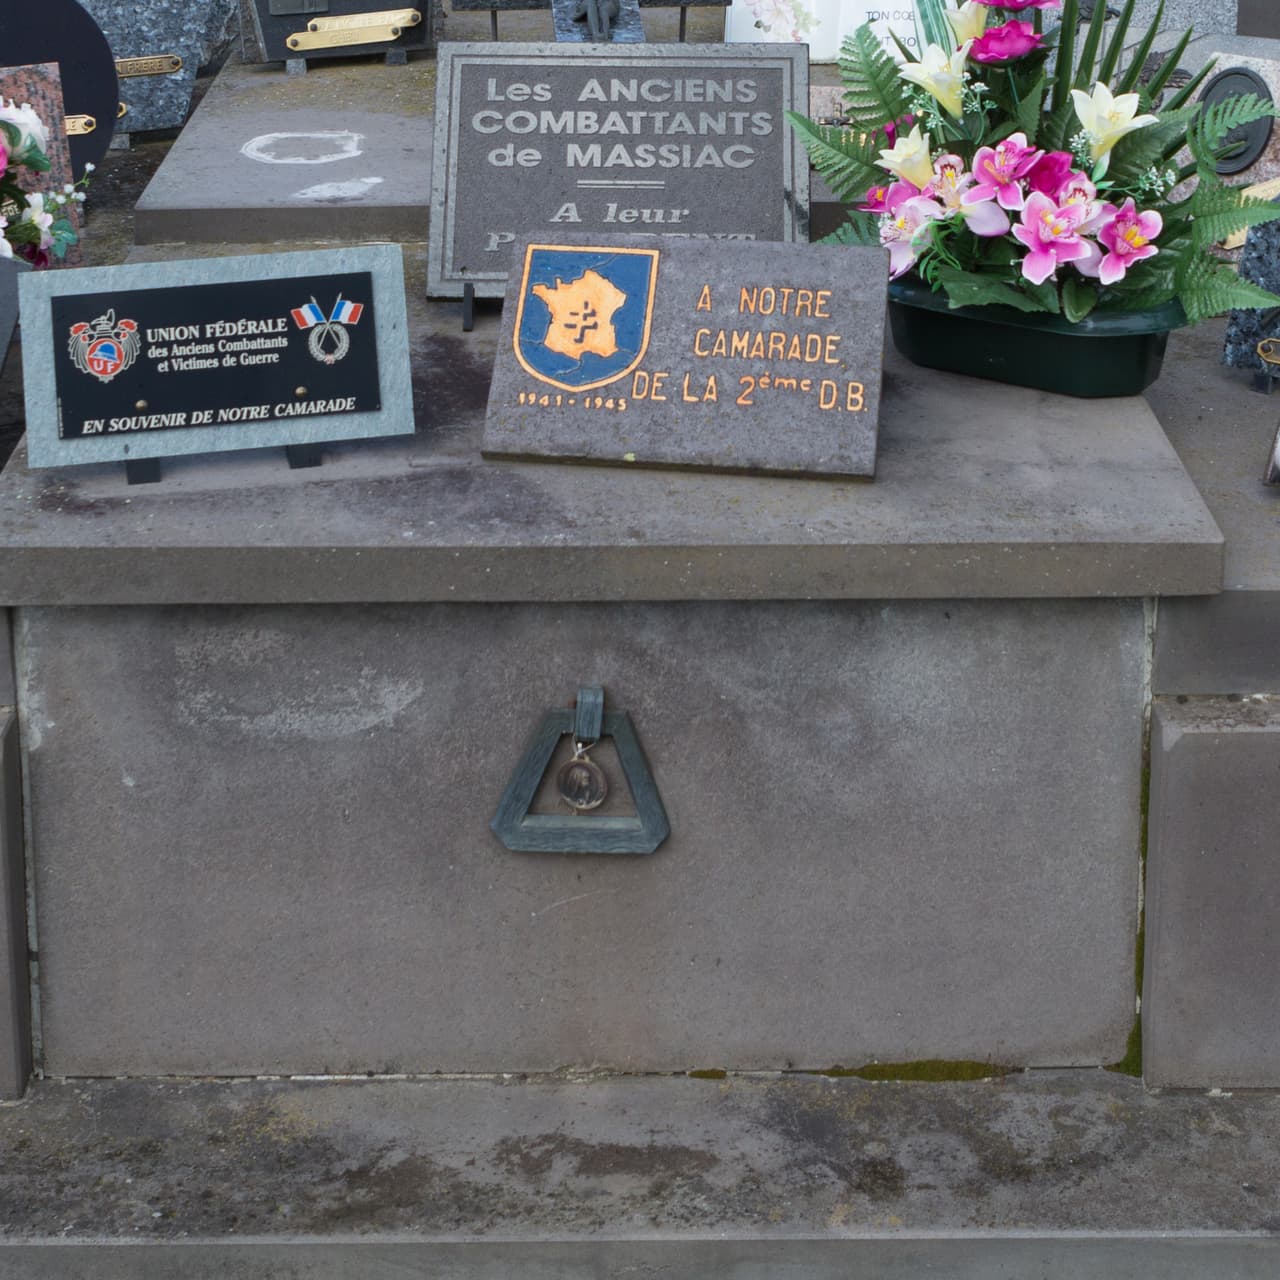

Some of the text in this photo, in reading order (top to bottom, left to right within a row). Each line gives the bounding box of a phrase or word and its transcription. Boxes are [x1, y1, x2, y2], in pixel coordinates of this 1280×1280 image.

[865, 10, 890, 21] TON
[487, 78, 758, 103] Les ANCIENS
[472, 110, 774, 136] COMBATTANTS
[488, 143, 755, 168] de MASSIAC
[549, 202, 691, 223] A leur
[696, 284, 832, 317] A NOTRE
[146, 318, 288, 343] UNION FÉDÉRALE
[148, 336, 288, 358] des Anciens Combattants
[694, 329, 841, 364] CAMARADE
[157, 353, 280, 373] et Victimes de Guerre
[631, 372, 669, 400] DE
[683, 374, 717, 402] LA
[519, 392, 562, 407] 1941
[584, 397, 627, 411] 1945
[82, 397, 356, 434] EN SOUVENIR DE NOTRE CAMARADE
